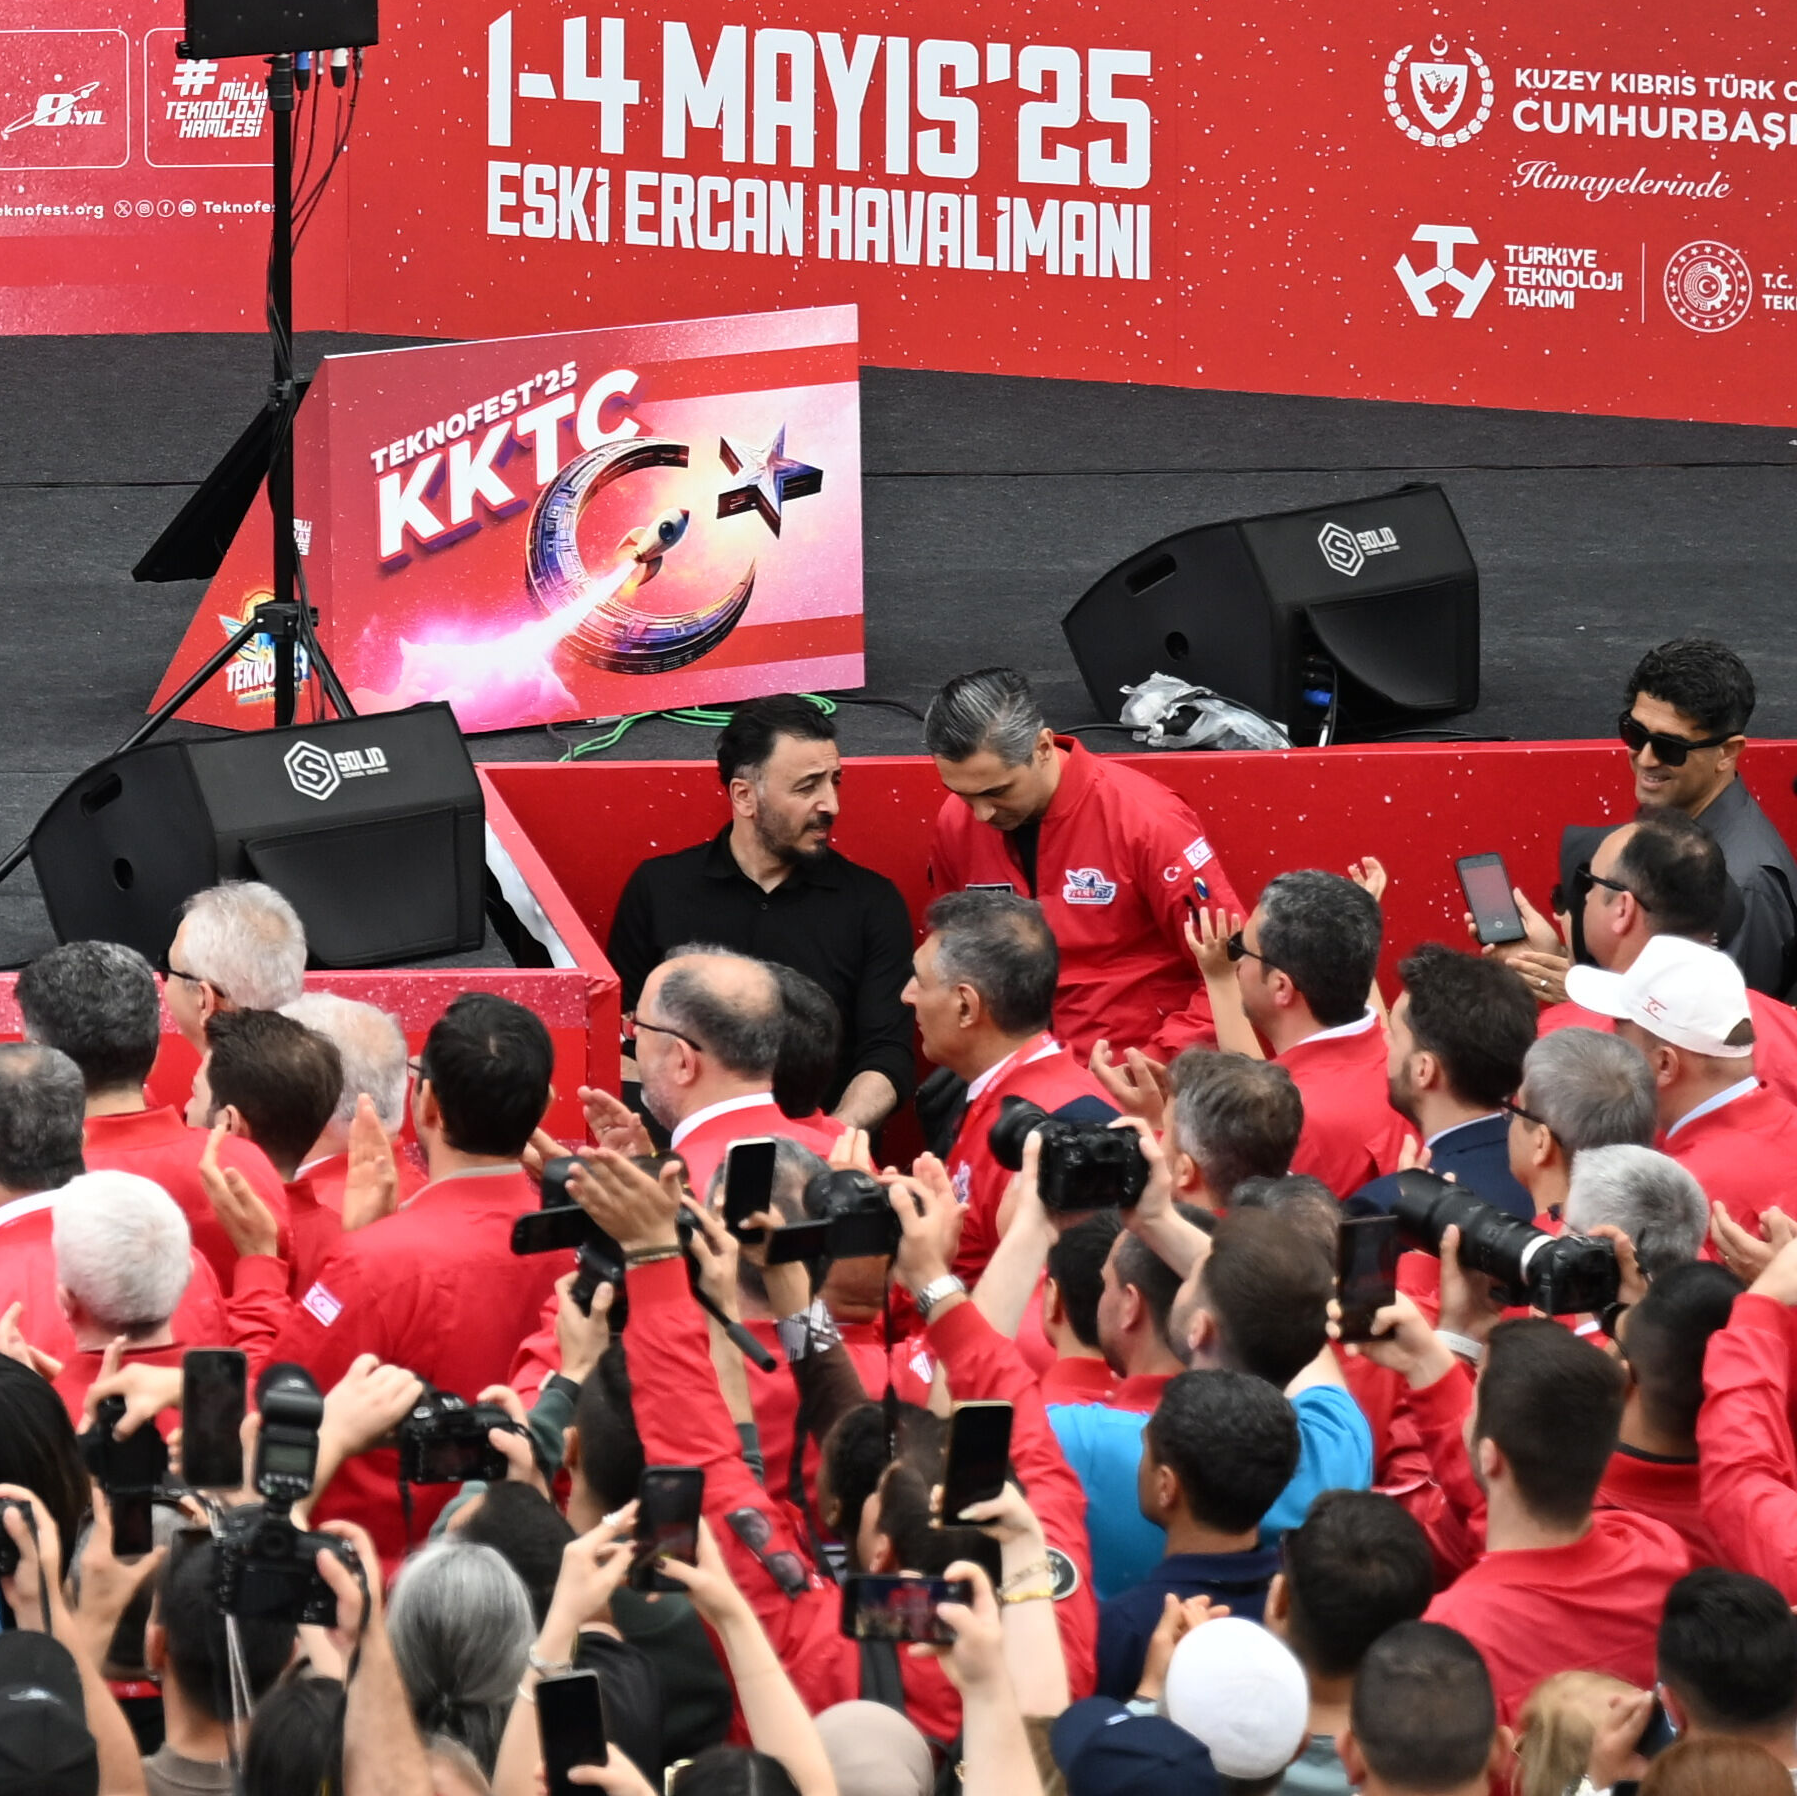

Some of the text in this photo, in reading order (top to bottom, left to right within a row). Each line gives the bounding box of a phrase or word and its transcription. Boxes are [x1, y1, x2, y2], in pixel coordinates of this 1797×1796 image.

[1515, 67, 1603, 91] KUZEY
[1610, 72, 1697, 97] KIBRIS
[1704, 73, 1776, 101] TÜRK
[661, 20, 1152, 190] MAYIS'25
[1512, 159, 1734, 203] Himayelerinde
[487, 160, 1151, 283] ESKİ ERCAN HAVALİMANI
[1504, 244, 1598, 269] TÜRKİYE
[1504, 287, 1575, 310] TAKIMI
[1761, 273, 1793, 290] T.C.
[370, 361, 579, 474] TEKNOFEST'25
[377, 368, 642, 564] KKTC
[1356, 526, 1398, 551] SOLID
[334, 746, 388, 773] SOLID
